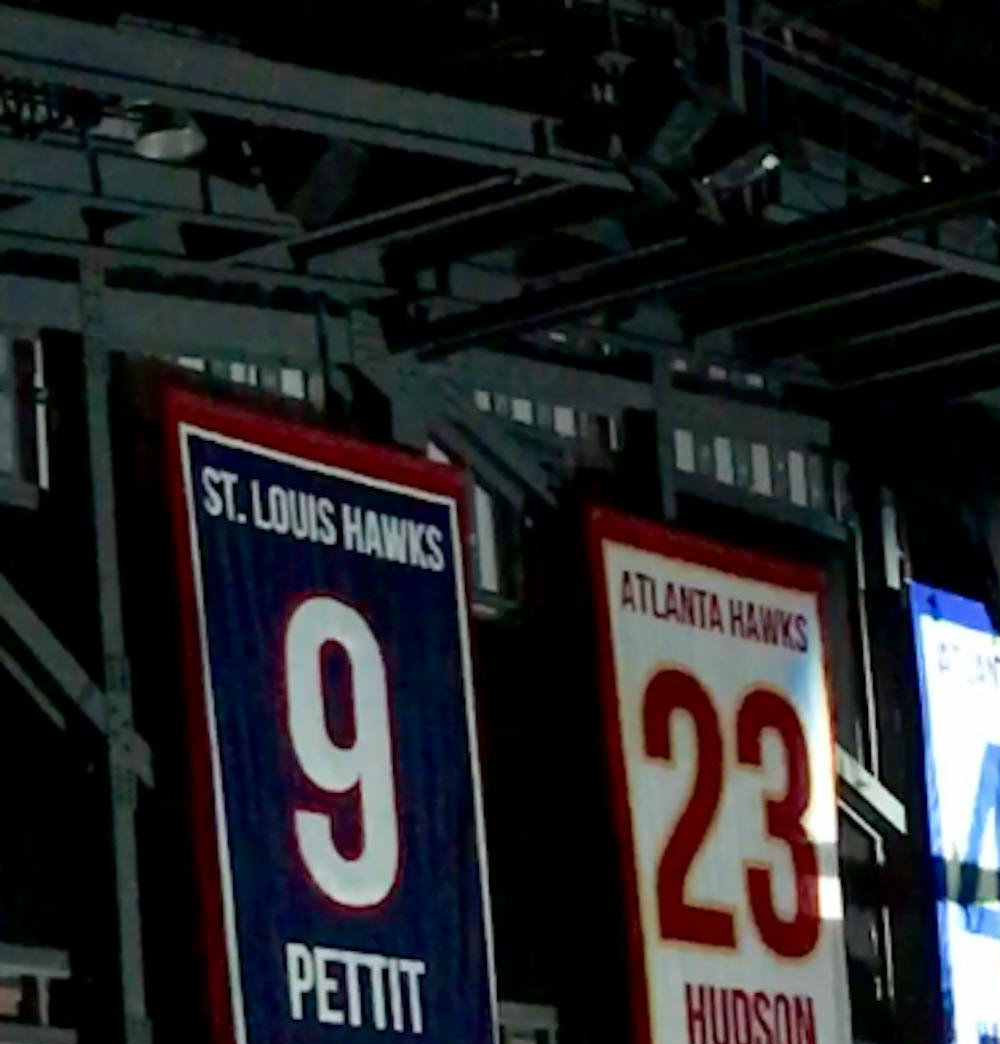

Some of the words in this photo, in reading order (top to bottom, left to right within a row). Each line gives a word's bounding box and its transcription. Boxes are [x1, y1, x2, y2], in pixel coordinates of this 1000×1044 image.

[201, 465, 247, 525] ST.
[251, 478, 338, 547] LOUIS
[341, 502, 446, 573] HAWKS
[621, 570, 724, 635] ATLANTA
[728, 597, 809, 653] HAWKS
[283, 592, 402, 911] 9
[641, 664, 824, 962] 23
[284, 942, 427, 1035] PETTIT
